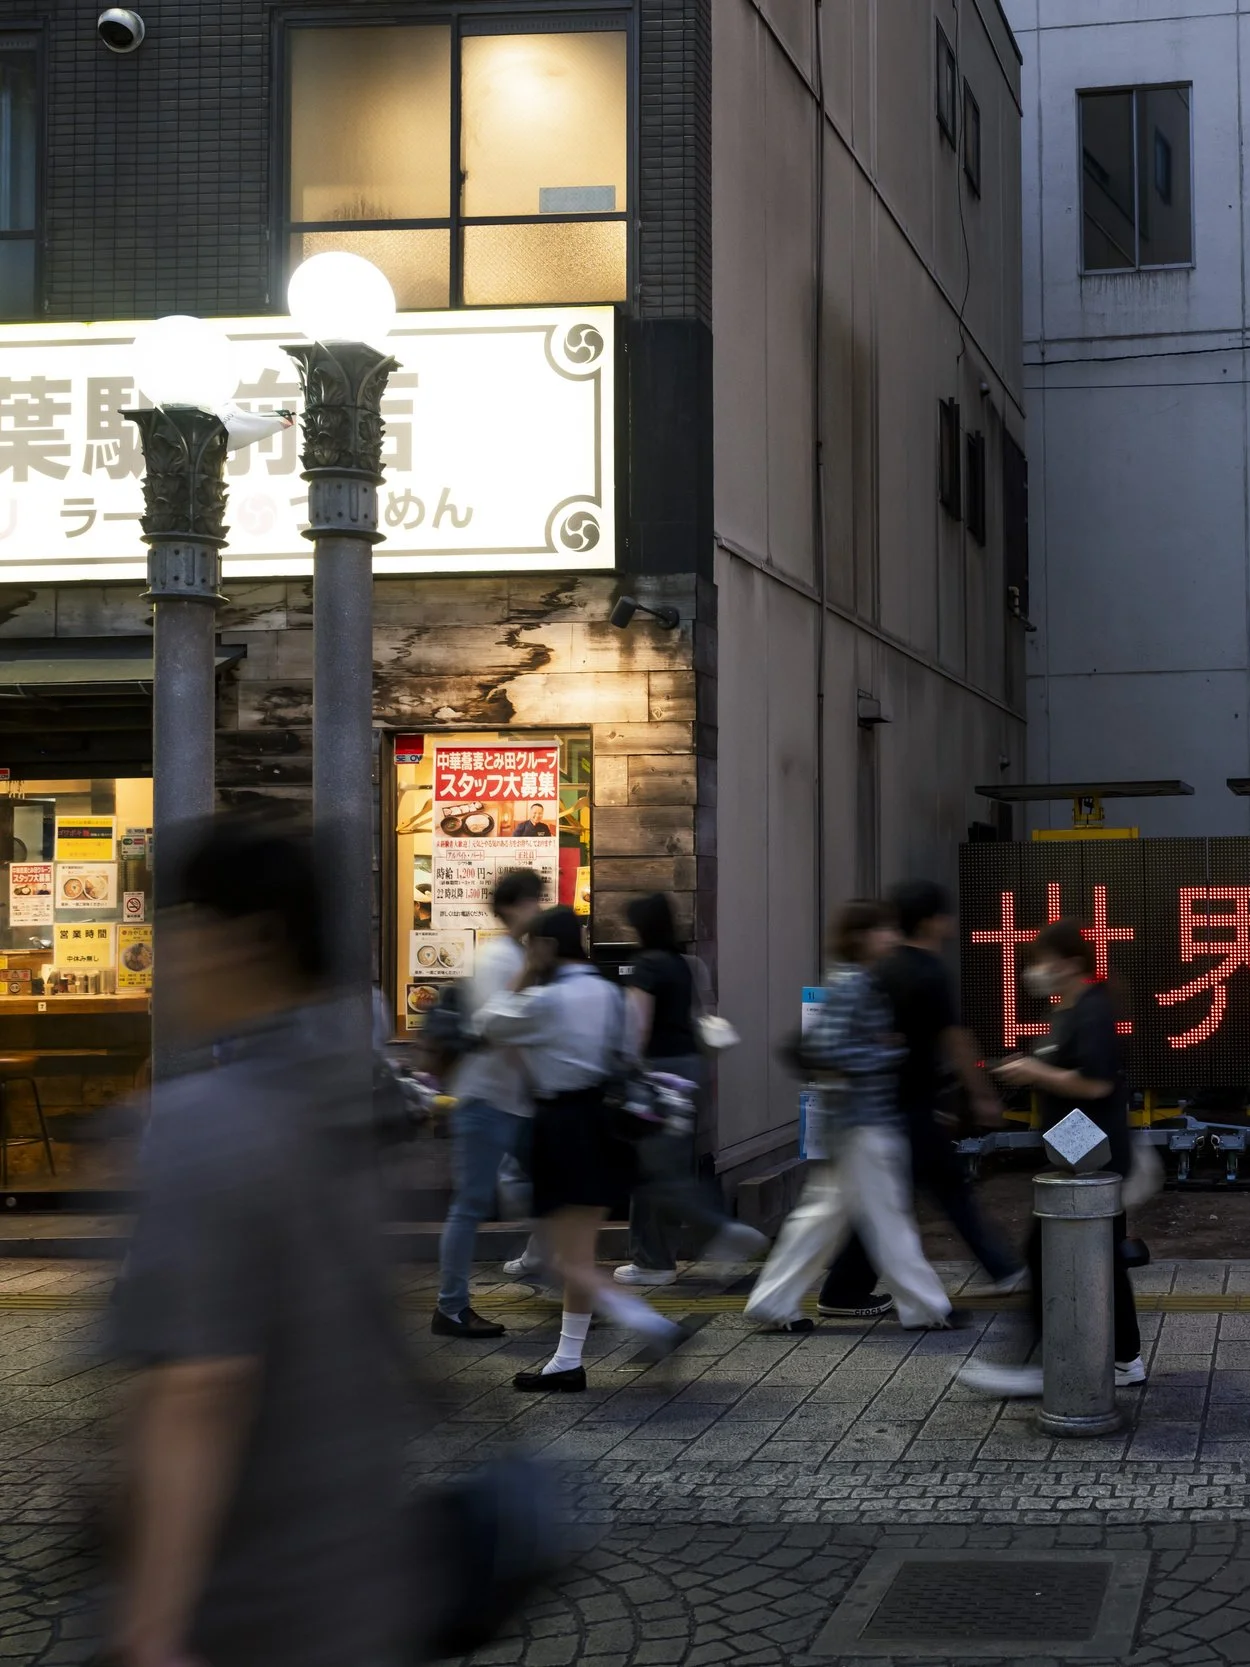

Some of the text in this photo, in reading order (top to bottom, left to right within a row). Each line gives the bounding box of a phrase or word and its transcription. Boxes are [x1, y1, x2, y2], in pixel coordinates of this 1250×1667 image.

[439, 771, 556, 798] スタッフ大募集
[60, 928, 107, 939] 営業時間
